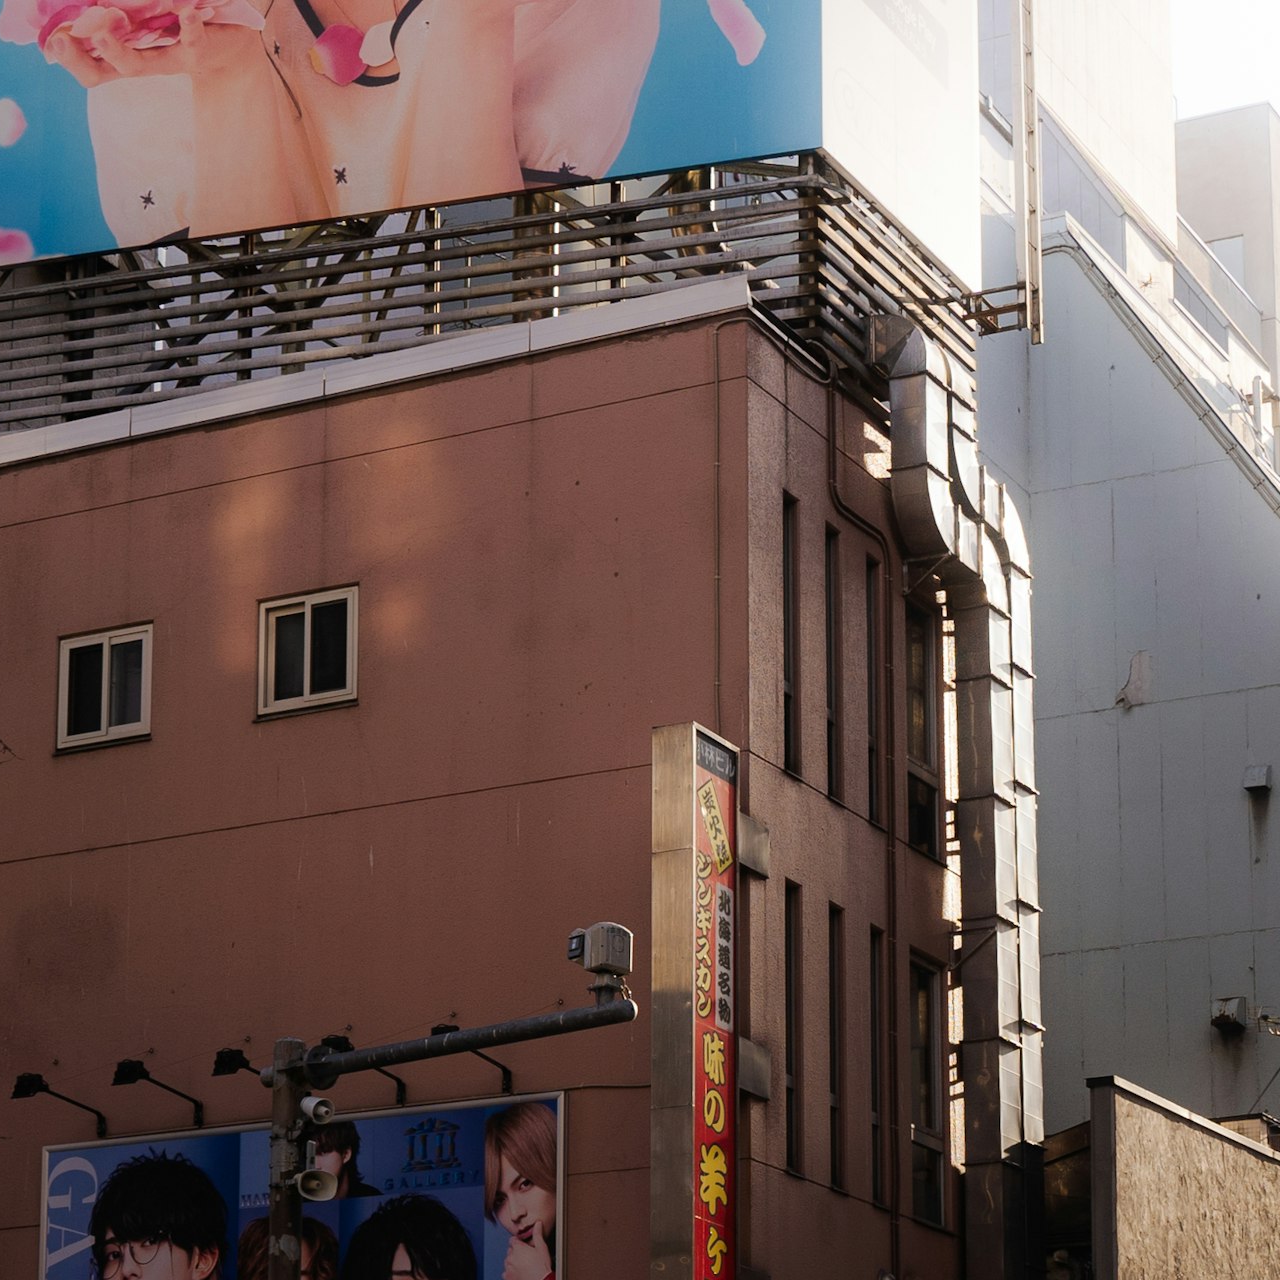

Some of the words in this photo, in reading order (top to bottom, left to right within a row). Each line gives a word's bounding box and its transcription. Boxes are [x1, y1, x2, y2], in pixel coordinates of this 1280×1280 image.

[696, 738, 736, 778] 小林ビル
[700, 784, 732, 868] 炭火焼
[695, 852, 713, 1019] ジンギスカン
[716, 888, 734, 1027] 北海道名物
[383, 1170, 480, 1191] GALLERY
